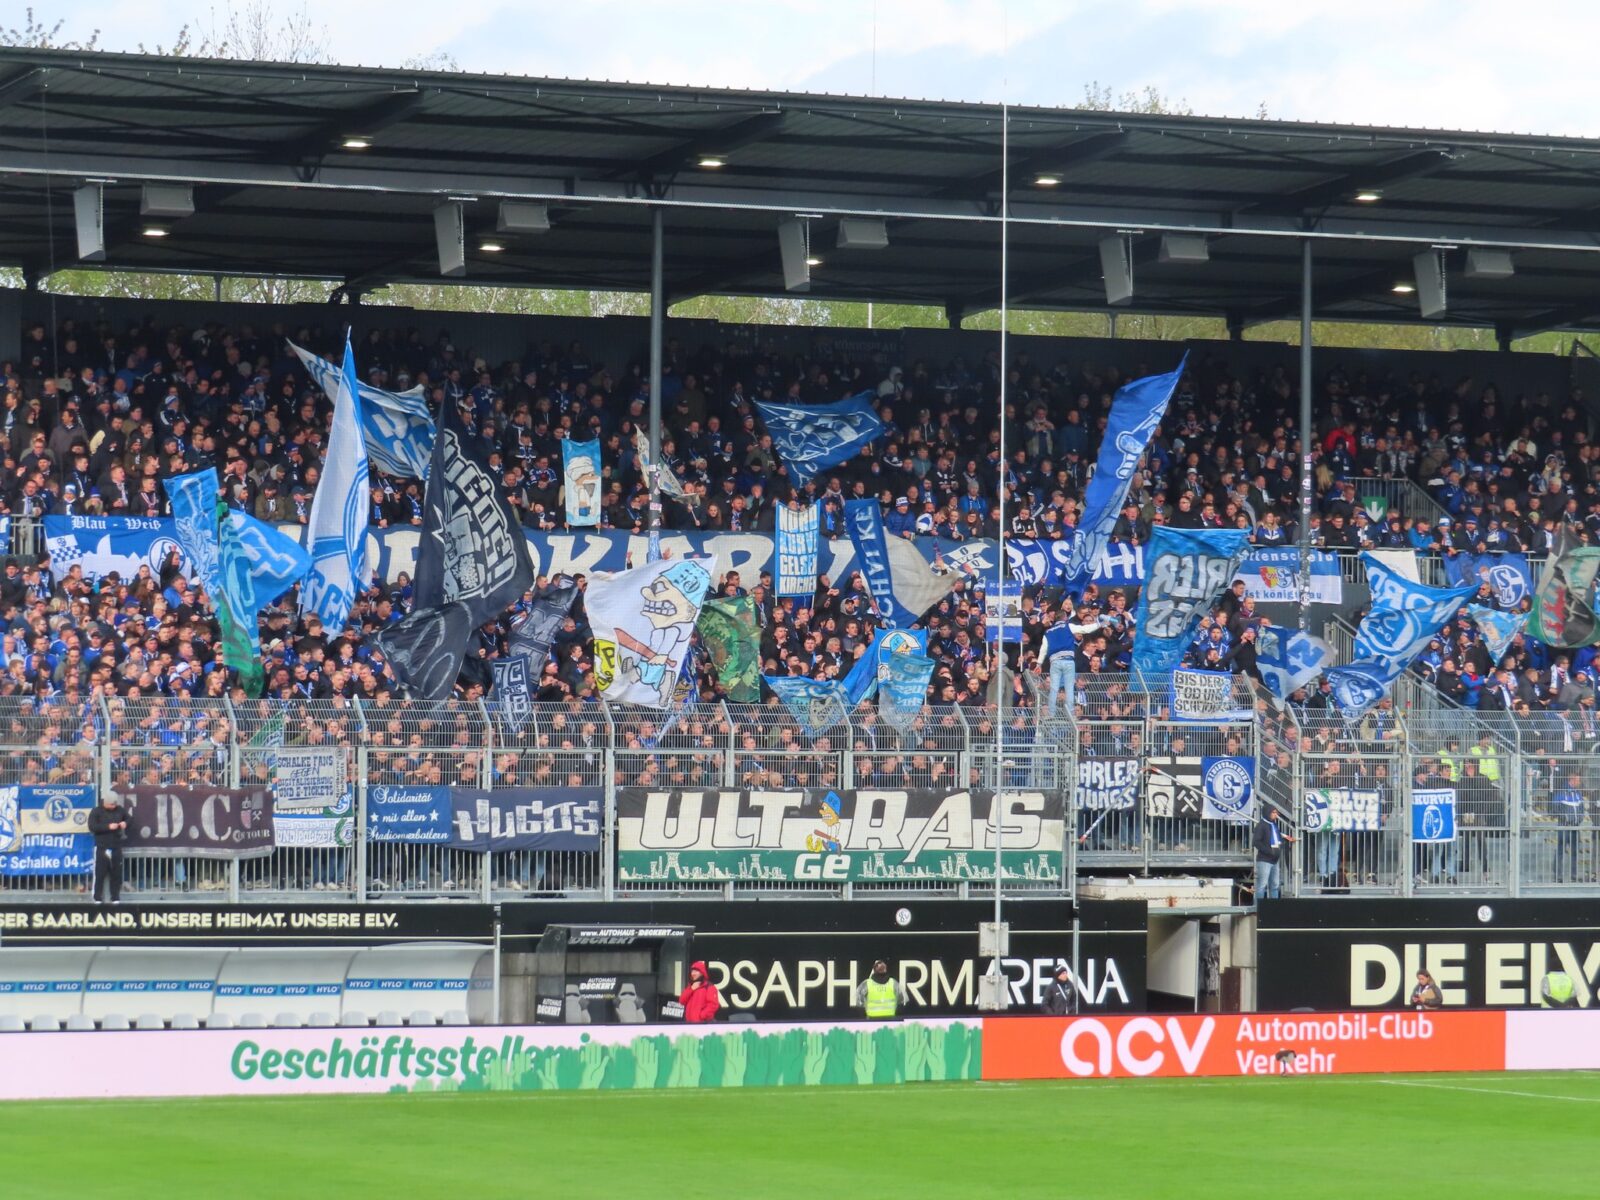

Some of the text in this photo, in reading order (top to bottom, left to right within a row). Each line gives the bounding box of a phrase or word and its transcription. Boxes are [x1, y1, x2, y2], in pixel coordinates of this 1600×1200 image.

[71, 515, 106, 530] Blau
[1077, 760, 1138, 790] ARLER
[1328, 789, 1380, 811] BLUE
[382, 810, 428, 823] mit allen
[1331, 810, 1380, 830] BOYZ
[10, 855, 60, 869] Schalke
[32, 912, 137, 928] SAARLAND.
[140, 912, 212, 928] UNSERE
[216, 912, 287, 928] HEIMAT.
[291, 912, 361, 928] UNSERE
[364, 913, 399, 928] ELV.
[1350, 943, 1467, 1007] DIE
[22, 983, 46, 991] HYLO
[55, 983, 79, 991] HYLO
[90, 981, 211, 990] HYLO HYLO HYLO HYLO
[220, 985, 338, 994] HYLO HYLO HYLO HYLO
[350, 980, 371, 988] HYLO
[381, 980, 403, 988] HYLO
[443, 981, 465, 989] HYLO
[1236, 1014, 1434, 1042] Automobil-Club
